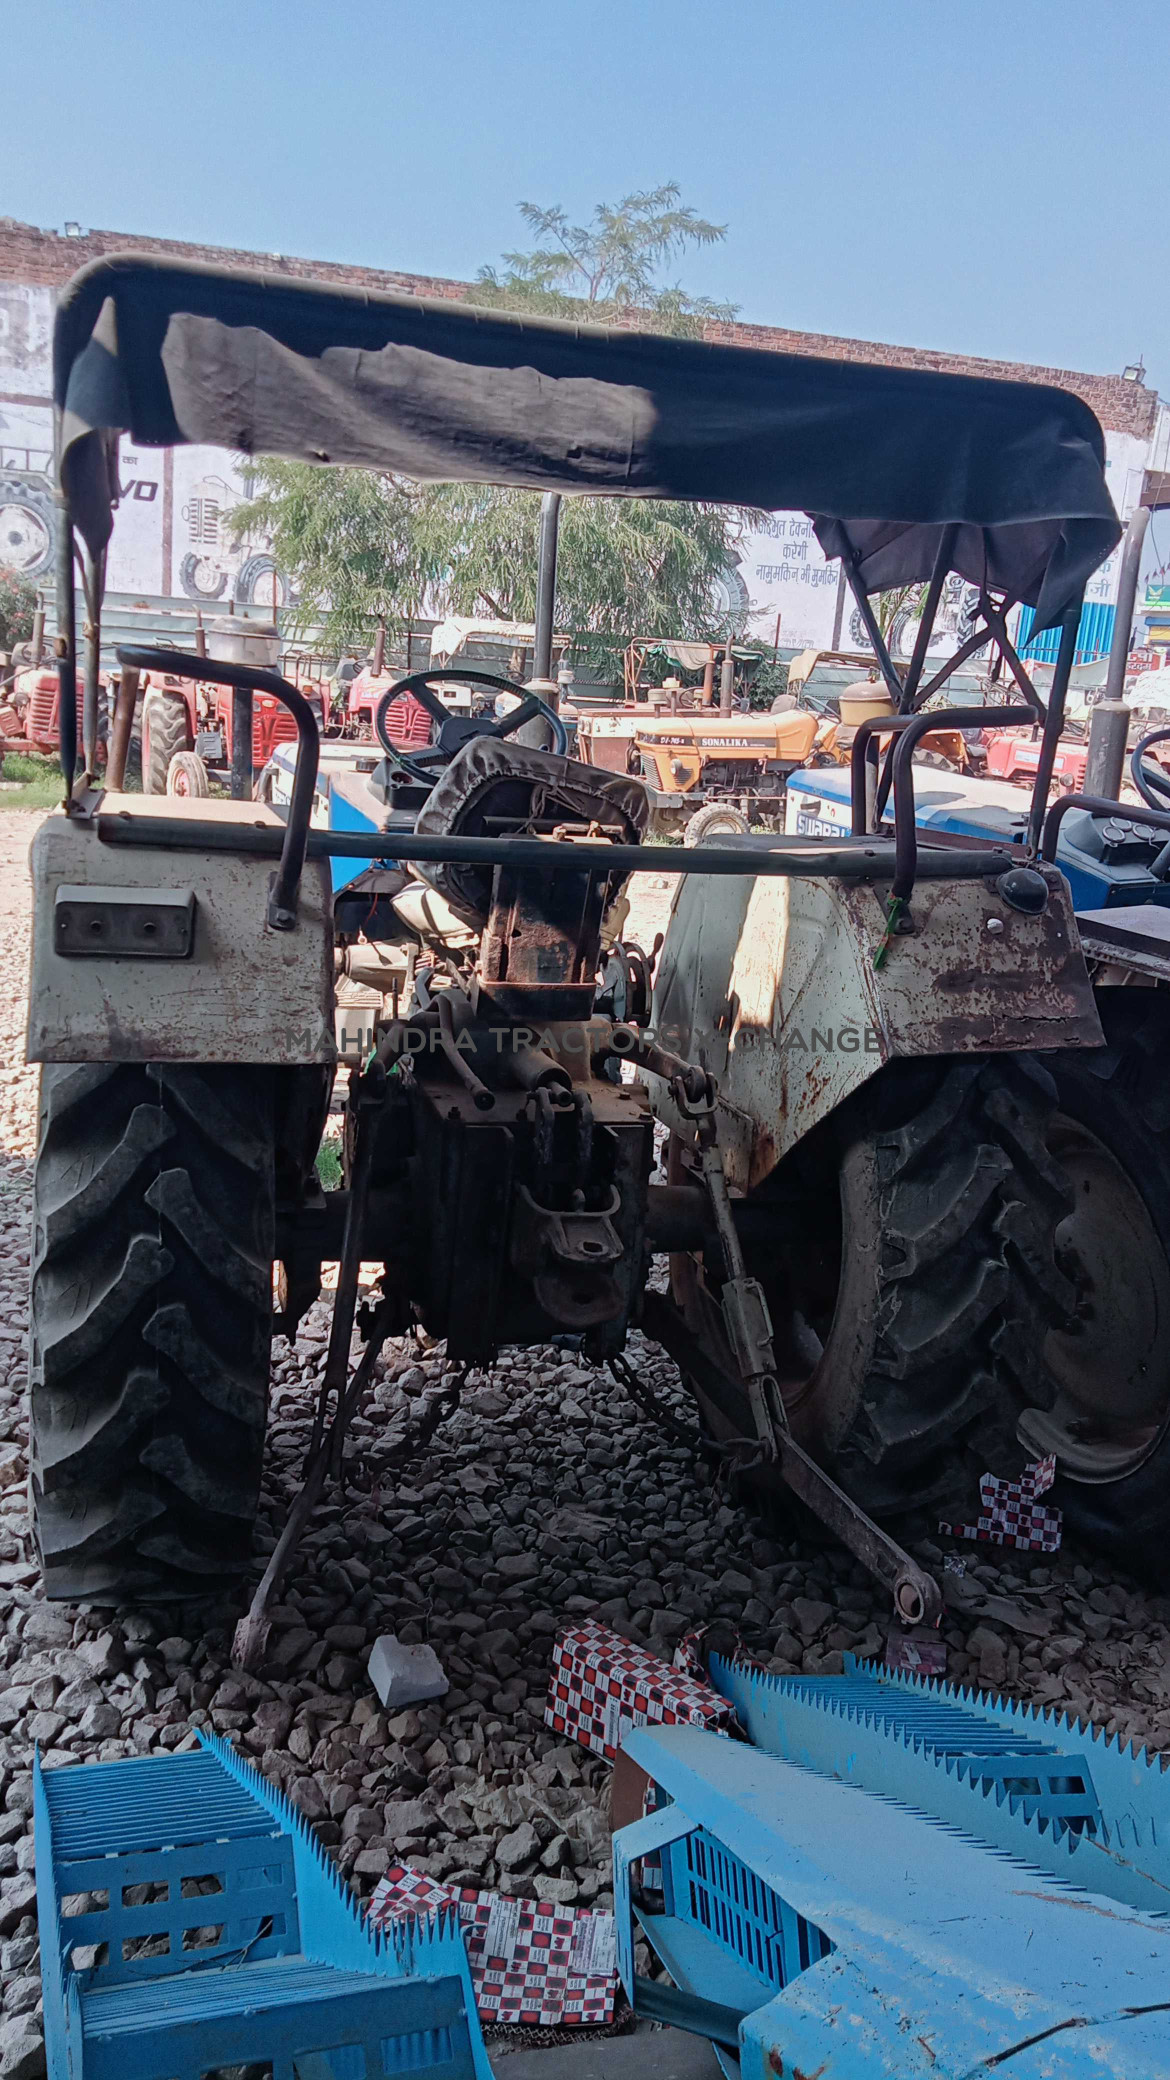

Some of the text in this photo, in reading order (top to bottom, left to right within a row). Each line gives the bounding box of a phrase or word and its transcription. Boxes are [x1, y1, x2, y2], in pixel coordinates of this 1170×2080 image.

[783, 541, 809, 561] करेगी
[800, 564, 811, 584] भी
[701, 737, 748, 747] SONALIKA
